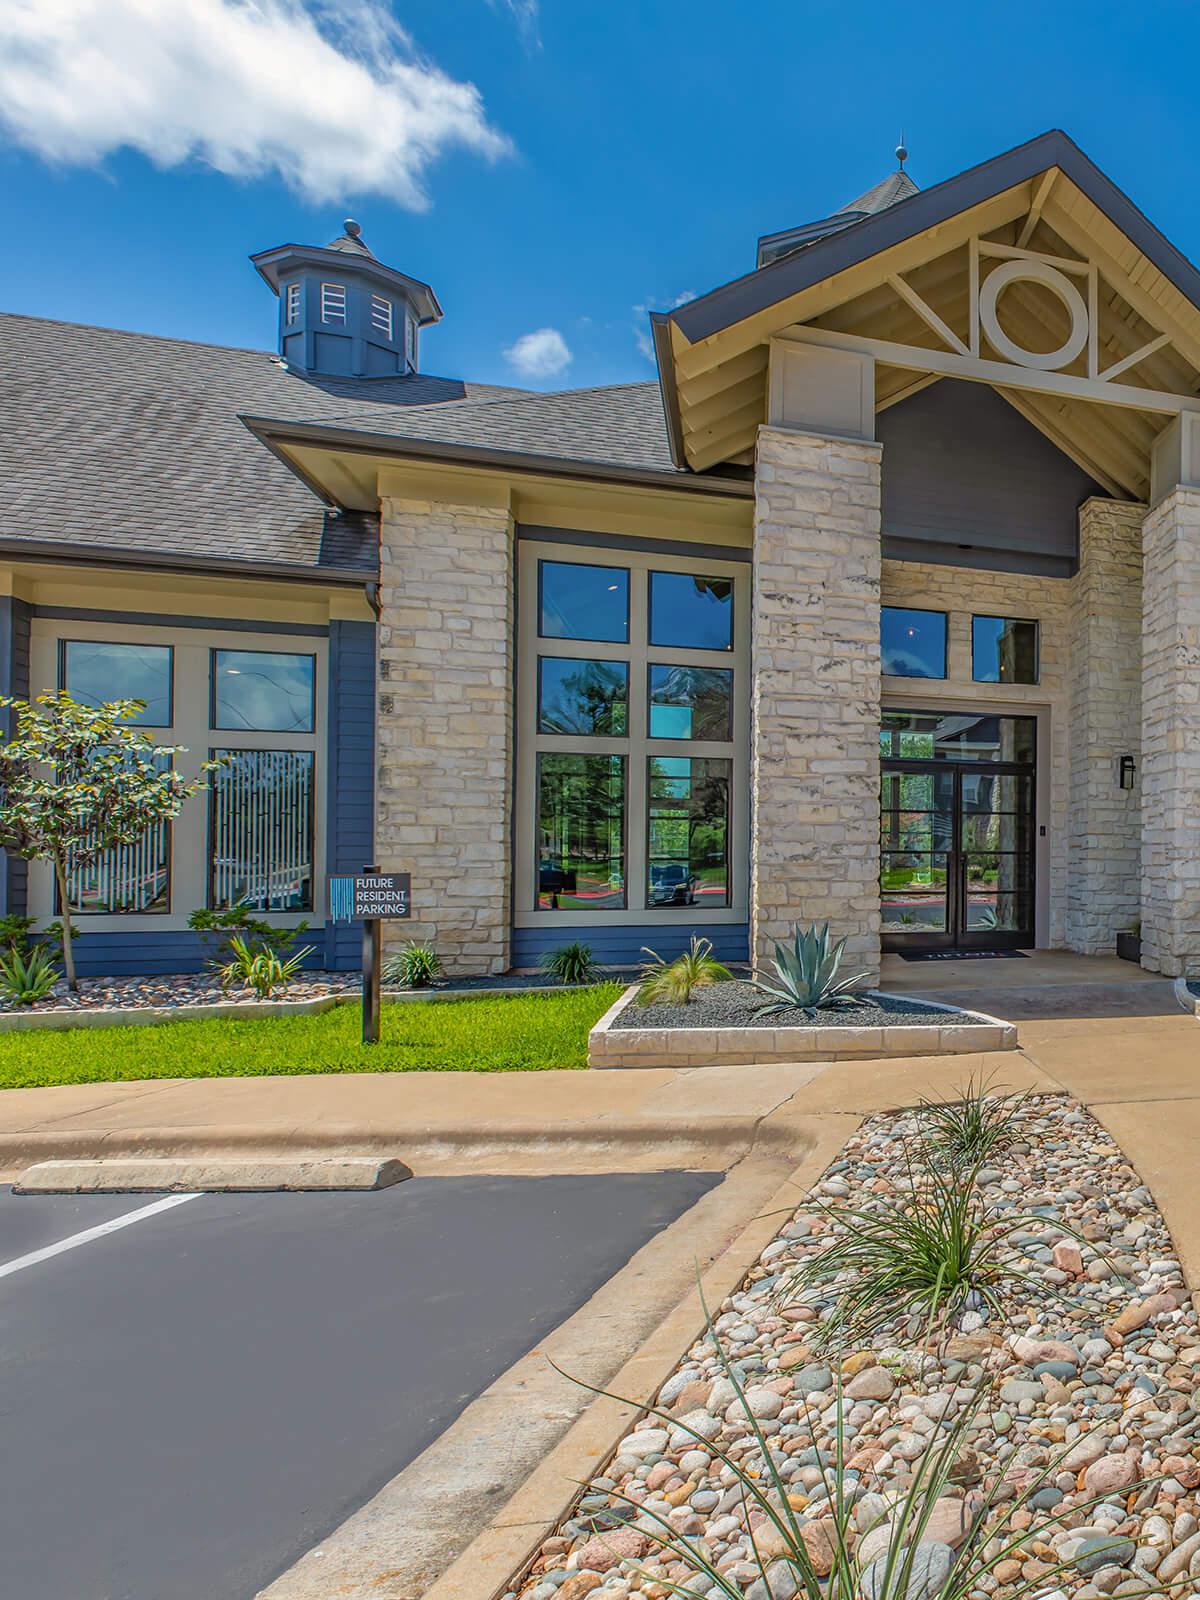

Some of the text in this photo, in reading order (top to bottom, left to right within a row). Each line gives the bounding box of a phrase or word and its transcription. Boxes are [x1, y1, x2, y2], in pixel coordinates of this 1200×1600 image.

[356, 878, 393, 889] FUTURE
[356, 890, 406, 901] RESIDENT
[356, 903, 406, 914] PARKING
